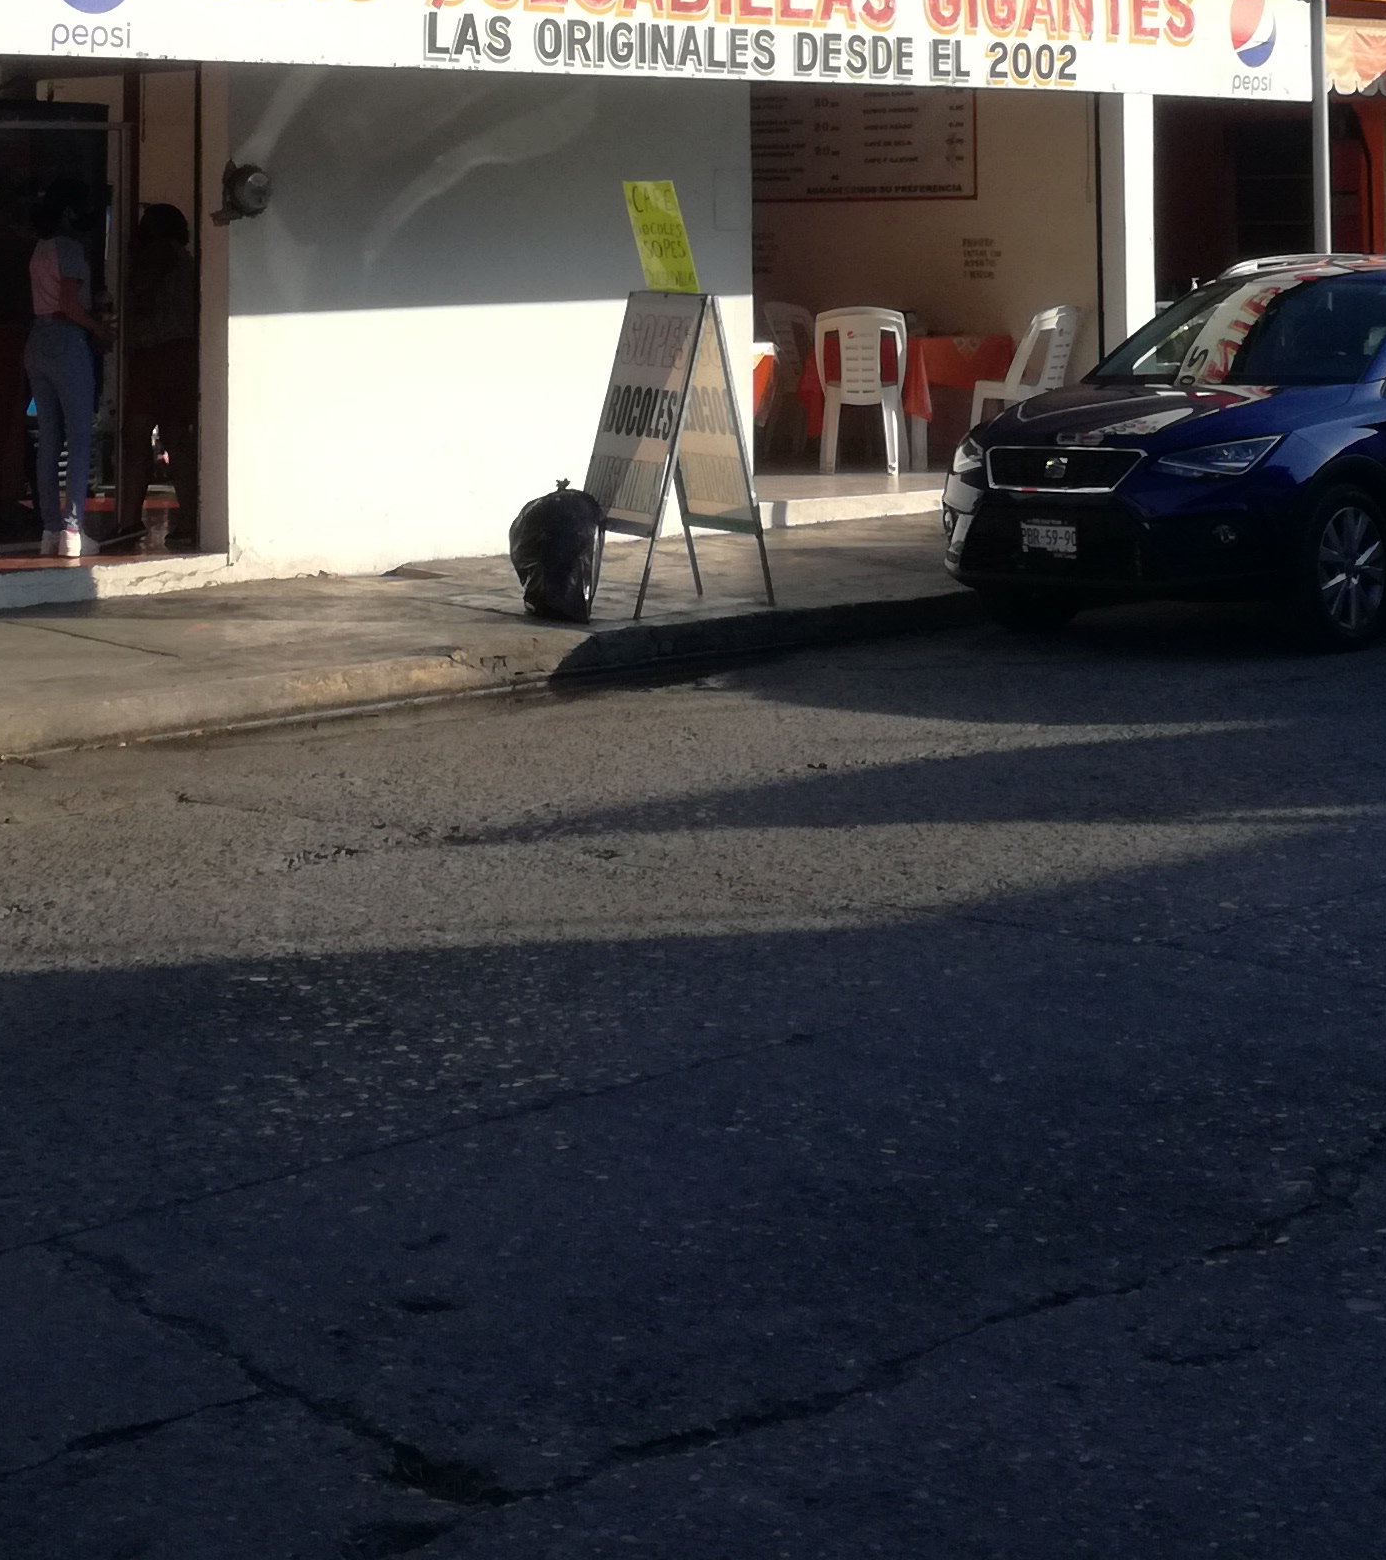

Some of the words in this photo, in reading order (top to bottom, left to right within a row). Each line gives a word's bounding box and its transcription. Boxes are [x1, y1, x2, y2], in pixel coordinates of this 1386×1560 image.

[51, 21, 131, 53] pepsi
[423, 11, 512, 64] LAS
[534, 17, 776, 77] ORIGINALES
[793, 31, 913, 81] DESDE
[929, 38, 971, 82] EL
[985, 41, 1078, 88] 2002
[1231, 71, 1273, 95] pepsi
[620, 312, 694, 370] SOPES
[603, 384, 678, 441] BOCOLES
